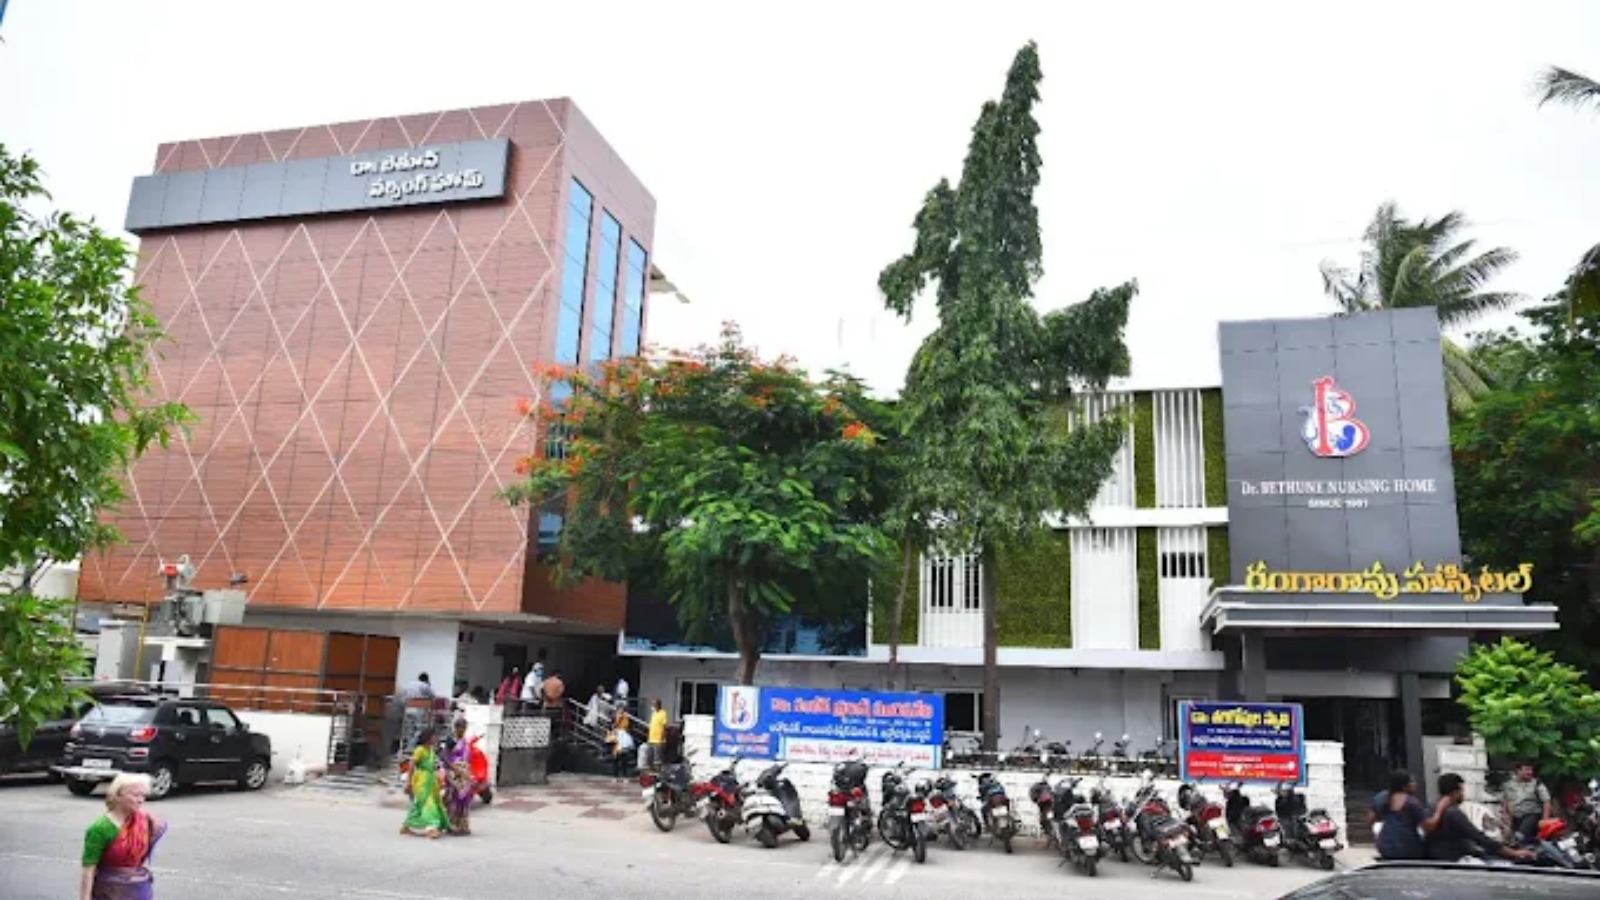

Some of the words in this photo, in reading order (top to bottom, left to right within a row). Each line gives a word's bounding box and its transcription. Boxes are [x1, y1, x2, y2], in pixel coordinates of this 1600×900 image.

[1241, 481, 1259, 494] Dr.
[1261, 480, 1323, 494] BETHUNE
[1327, 479, 1389, 493] NURSING
[1393, 478, 1436, 492] HOME
[1246, 561, 1400, 600] రంగారావు
[1404, 561, 1535, 602] హాస్పిటల్
